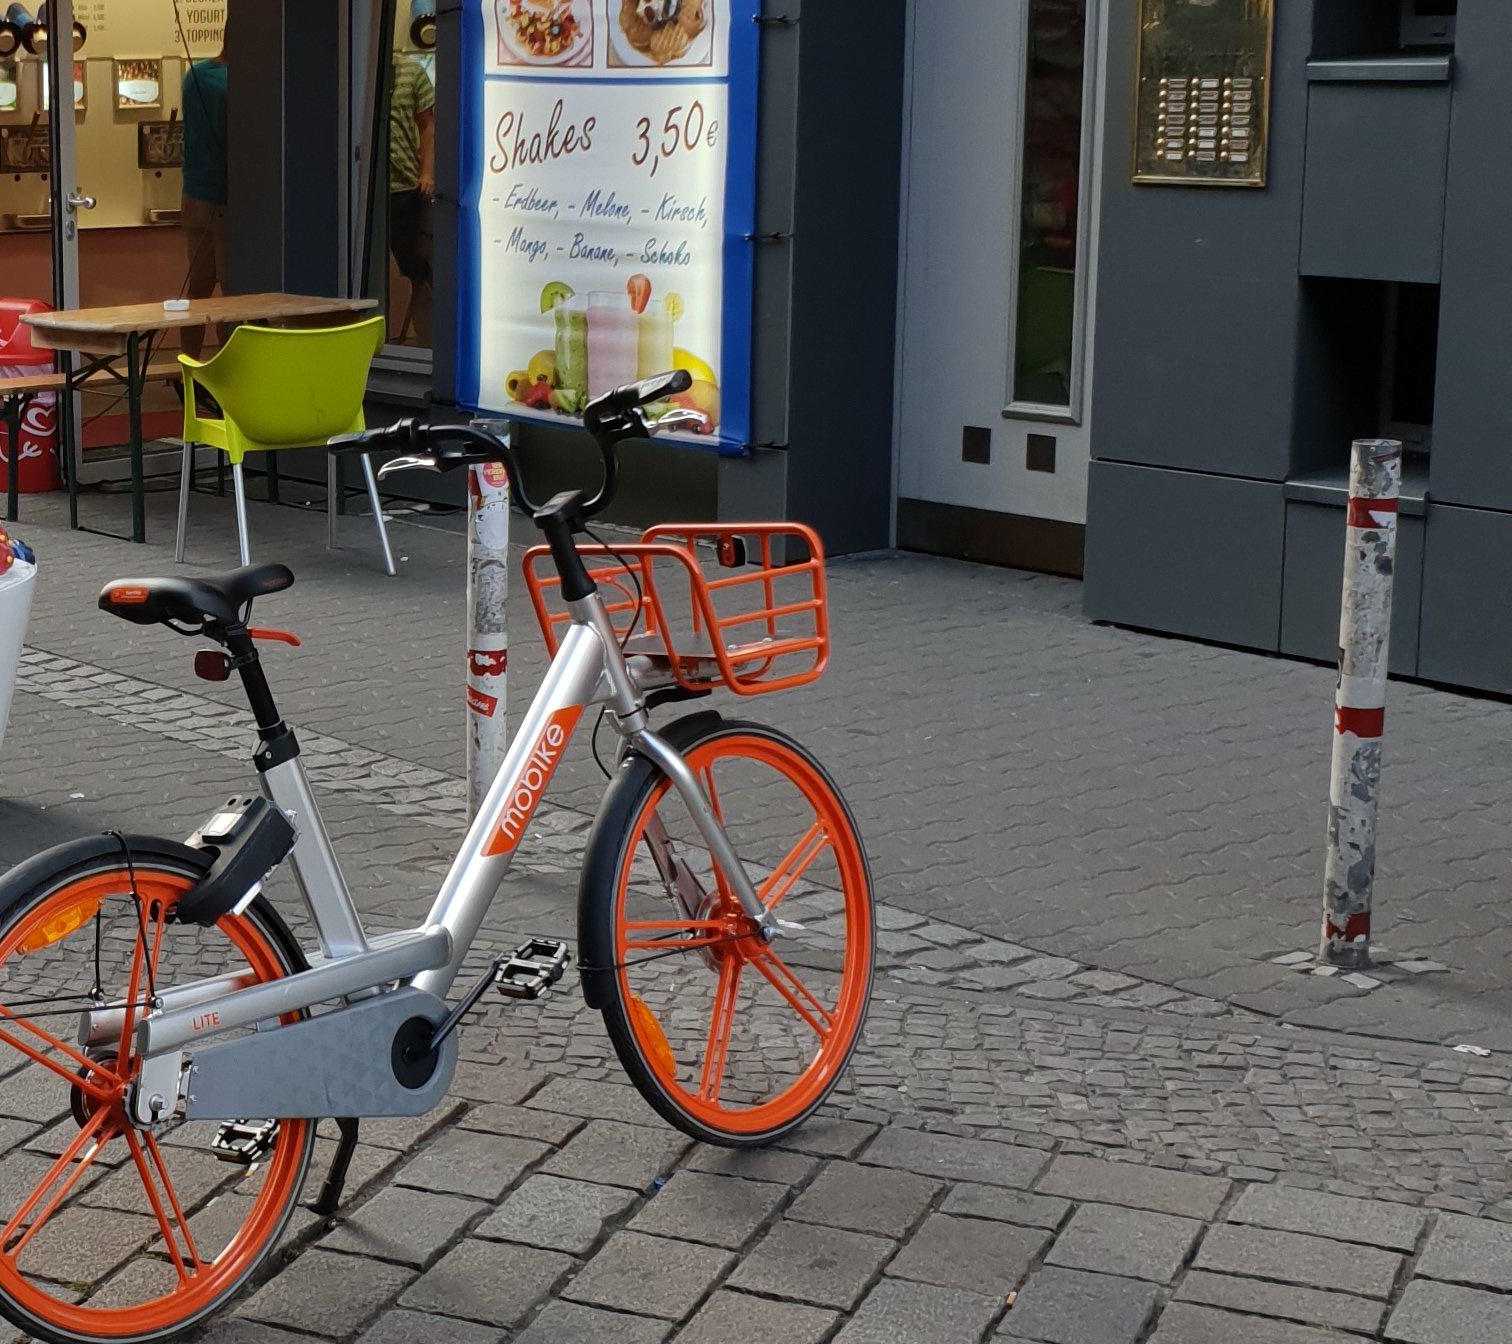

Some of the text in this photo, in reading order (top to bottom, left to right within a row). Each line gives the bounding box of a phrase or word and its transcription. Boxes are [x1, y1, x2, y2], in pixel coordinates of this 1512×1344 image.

[186, 9, 225, 23] YOGURT
[490, 99, 596, 174] Shakes
[504, 184, 559, 219] Erdbeer,
[579, 189, 632, 225] Melone,
[655, 192, 708, 228] Kirsch,
[505, 226, 548, 263] Mango,
[569, 232, 619, 267] Banane,
[640, 238, 690, 265] Schoko
[501, 724, 564, 840] mobike
[192, 1011, 220, 1031] LITE
